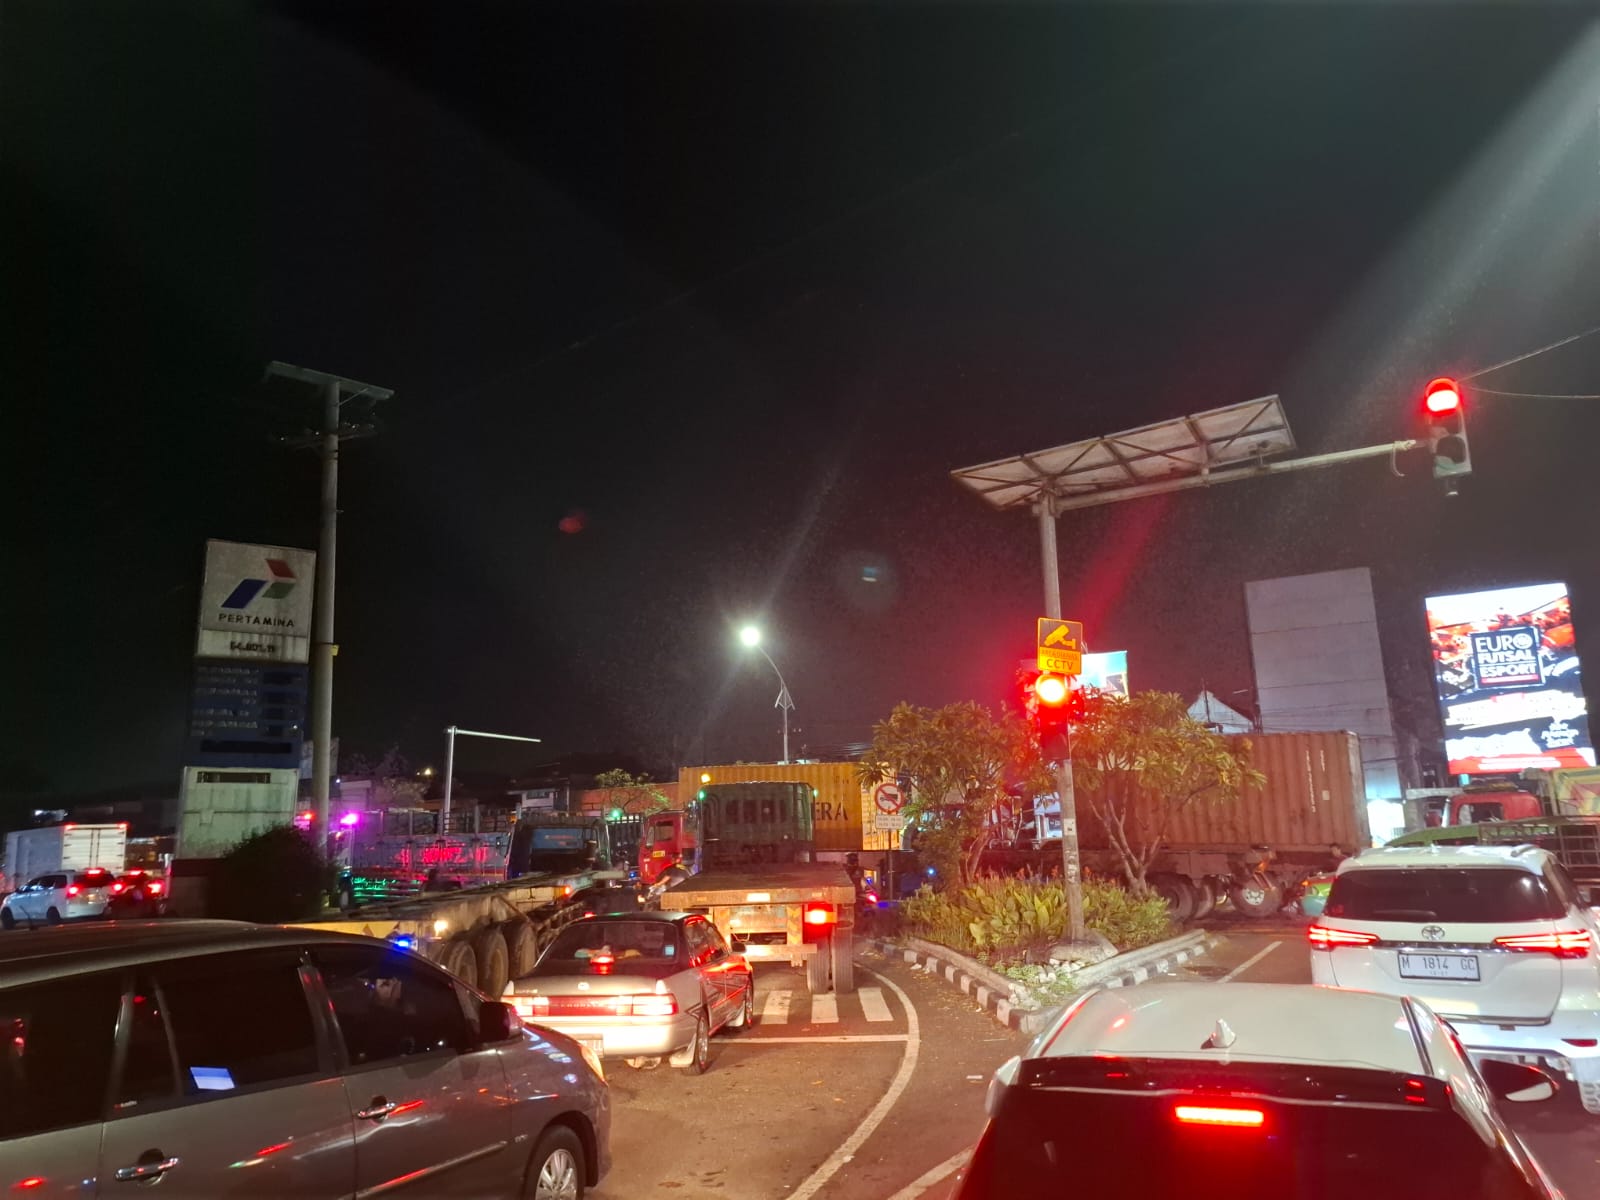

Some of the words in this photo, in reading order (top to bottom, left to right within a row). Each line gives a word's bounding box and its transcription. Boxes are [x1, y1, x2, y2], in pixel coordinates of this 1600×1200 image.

[218, 612, 295, 628] PERTAMINA
[1475, 633, 1533, 653] EURO
[1477, 650, 1536, 664] FUTSAL
[1046, 658, 1074, 671] CCTV
[1479, 663, 1538, 678] ESPORT
[1401, 956, 1410, 969] M
[1422, 957, 1449, 970] 1814
